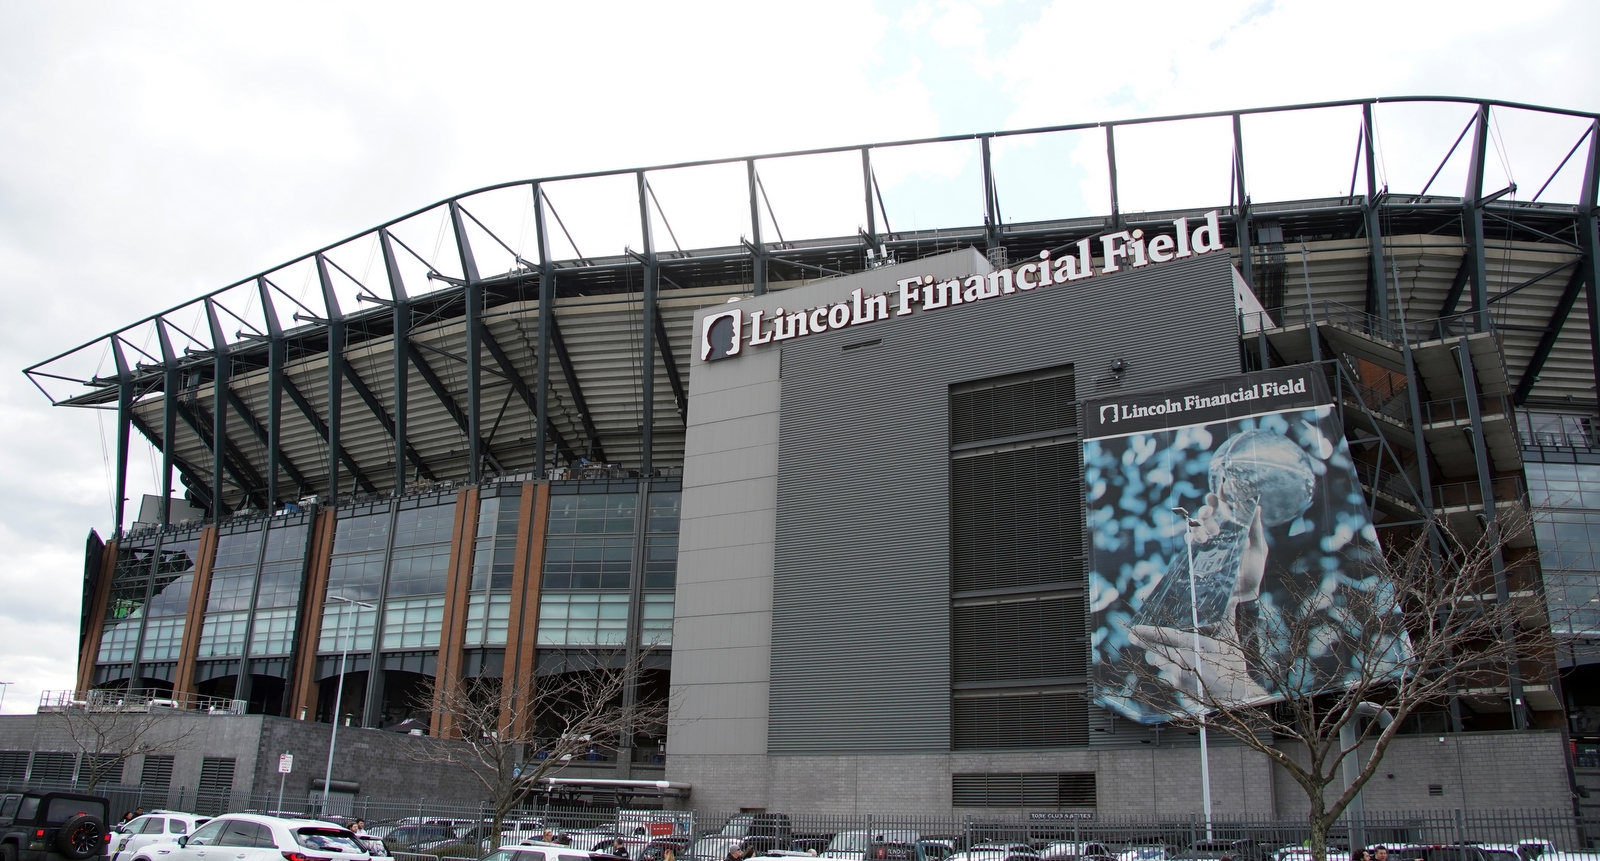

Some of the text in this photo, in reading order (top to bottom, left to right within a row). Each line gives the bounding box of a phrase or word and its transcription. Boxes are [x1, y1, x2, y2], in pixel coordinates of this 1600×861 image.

[749, 209, 1224, 346] Lincoln Financial Field
[1121, 377, 1307, 420] Lincoln Financial Field
